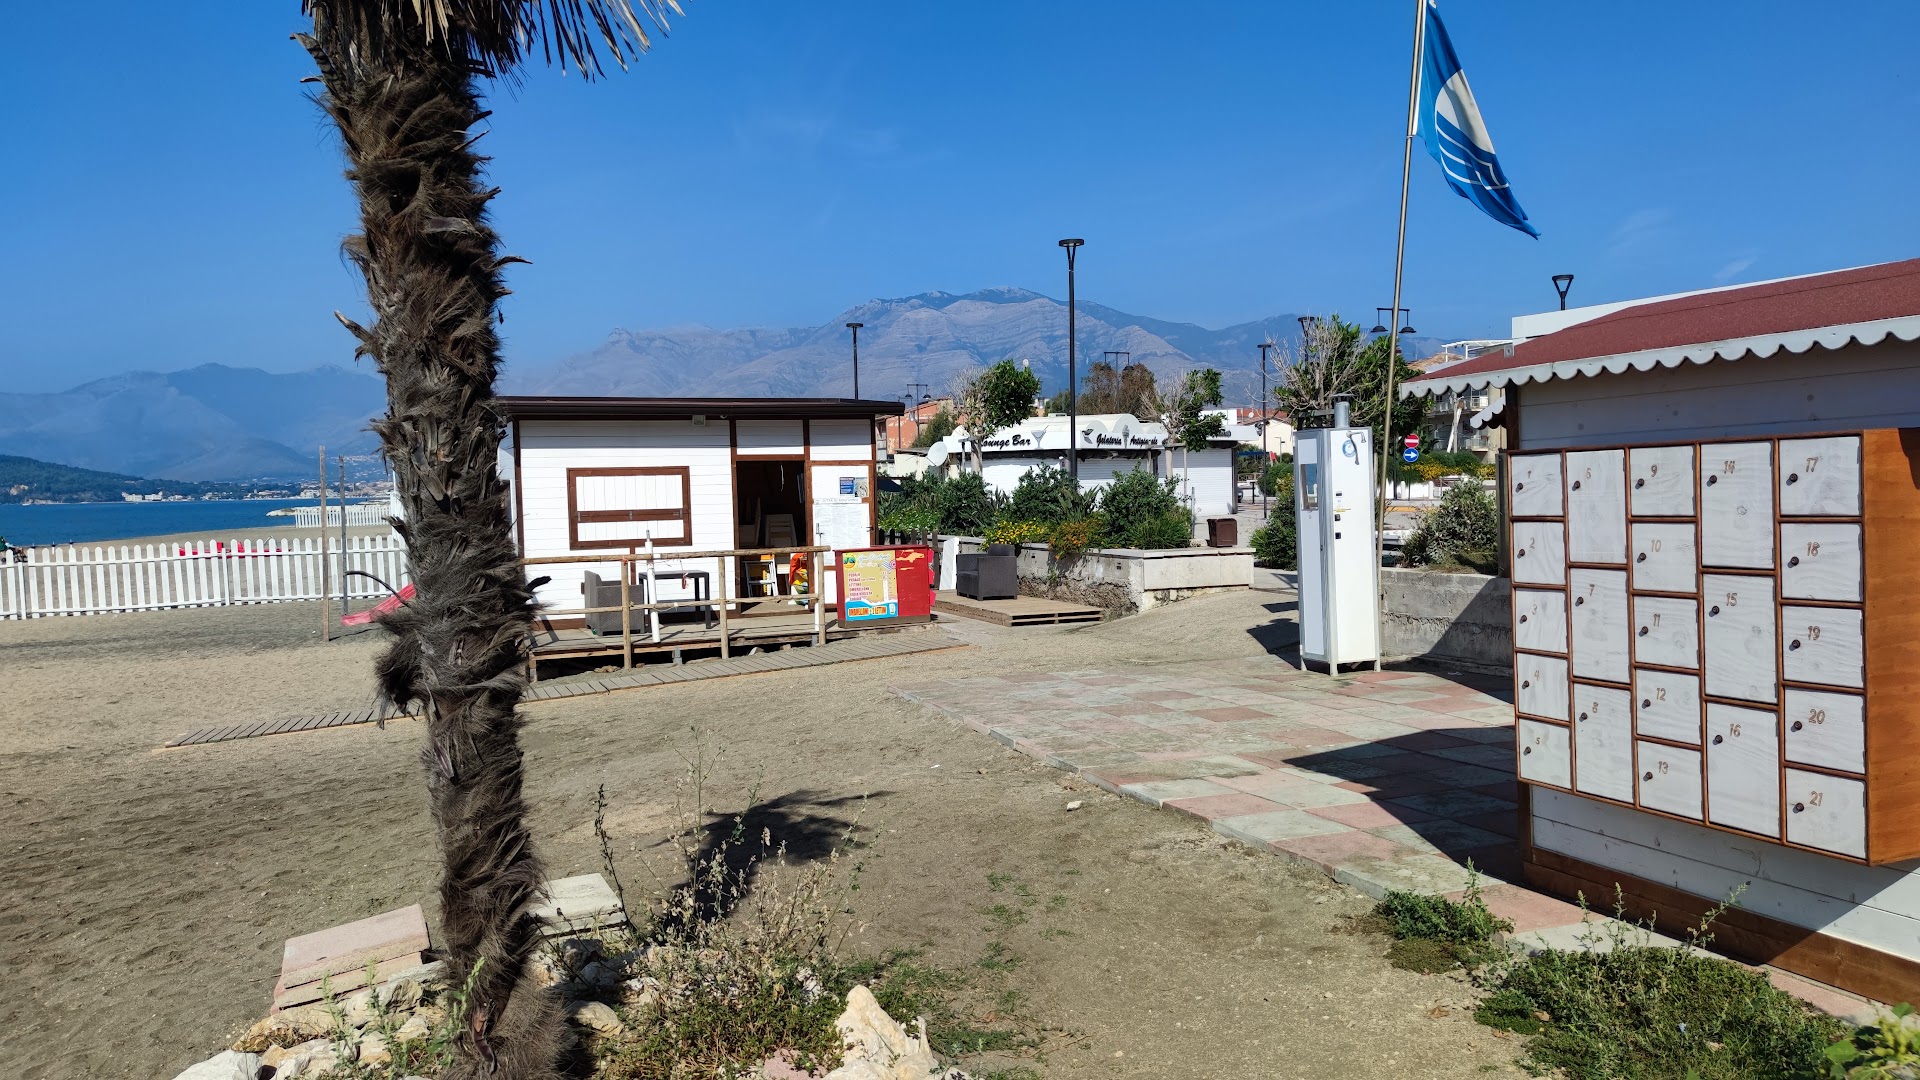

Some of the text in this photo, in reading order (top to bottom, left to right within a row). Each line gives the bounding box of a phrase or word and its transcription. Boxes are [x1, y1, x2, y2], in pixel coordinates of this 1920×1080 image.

[1012, 434, 1031, 446] Bar
[1096, 433, 1122, 448] Gelateria
[1651, 464, 1658, 477] 9
[1805, 456, 1819, 473] 17
[1529, 537, 1536, 550] 2
[1651, 539, 1662, 553] 10
[1807, 541, 1821, 557] 18
[1589, 584, 1596, 597] 7
[1726, 592, 1738, 607] 15
[1531, 603, 1538, 616] 3
[1653, 613, 1661, 627] 11
[1807, 625, 1821, 641] 19
[1533, 669, 1541, 682] 4
[1656, 687, 1667, 702] 12
[1808, 708, 1826, 725] 20
[1729, 723, 1742, 738] 16
[1535, 737, 1541, 746] 5
[1658, 760, 1669, 775] 13
[1809, 790, 1823, 807] 21
